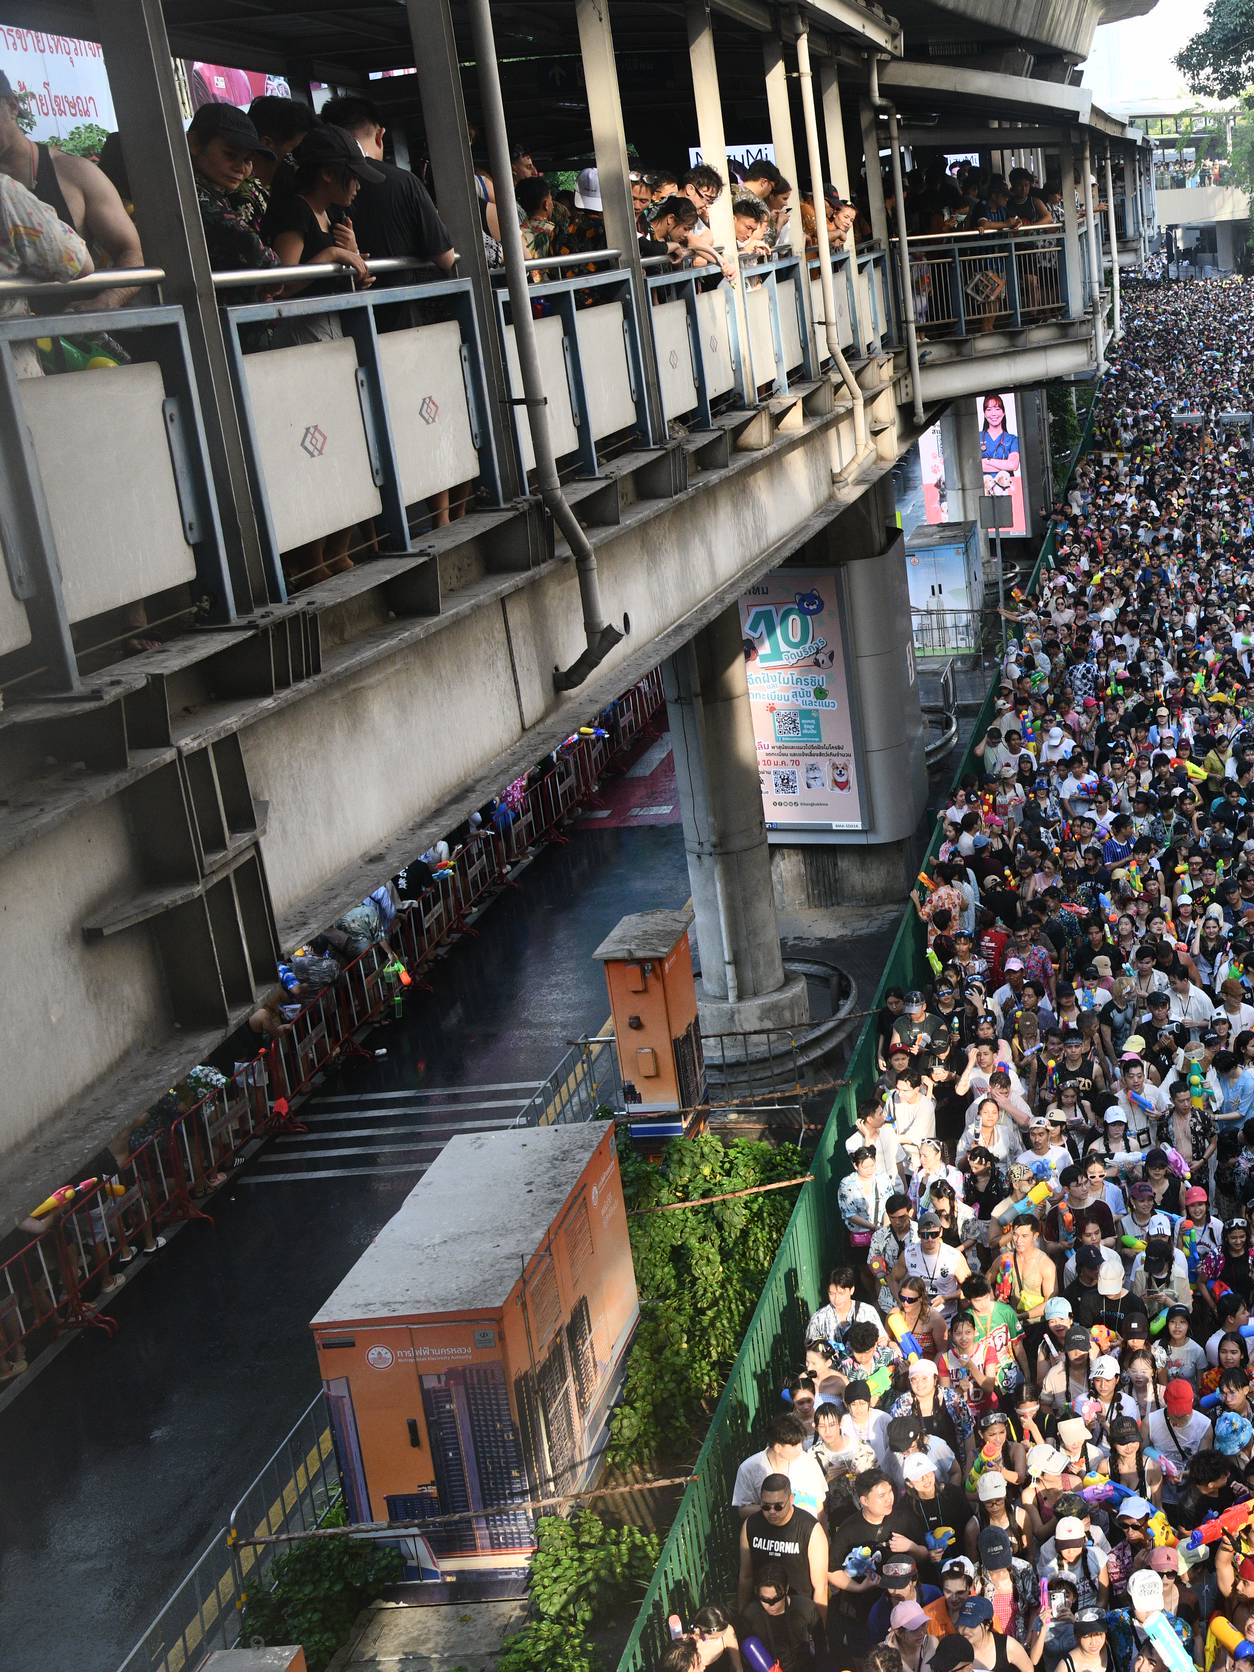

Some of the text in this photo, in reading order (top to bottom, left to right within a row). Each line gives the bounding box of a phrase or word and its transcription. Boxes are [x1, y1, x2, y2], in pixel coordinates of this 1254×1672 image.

[748, 607, 811, 663] 10
[397, 1346, 472, 1357] การไฟฟ้านครหลวง
[752, 1536, 800, 1554] CALIFORNIA
